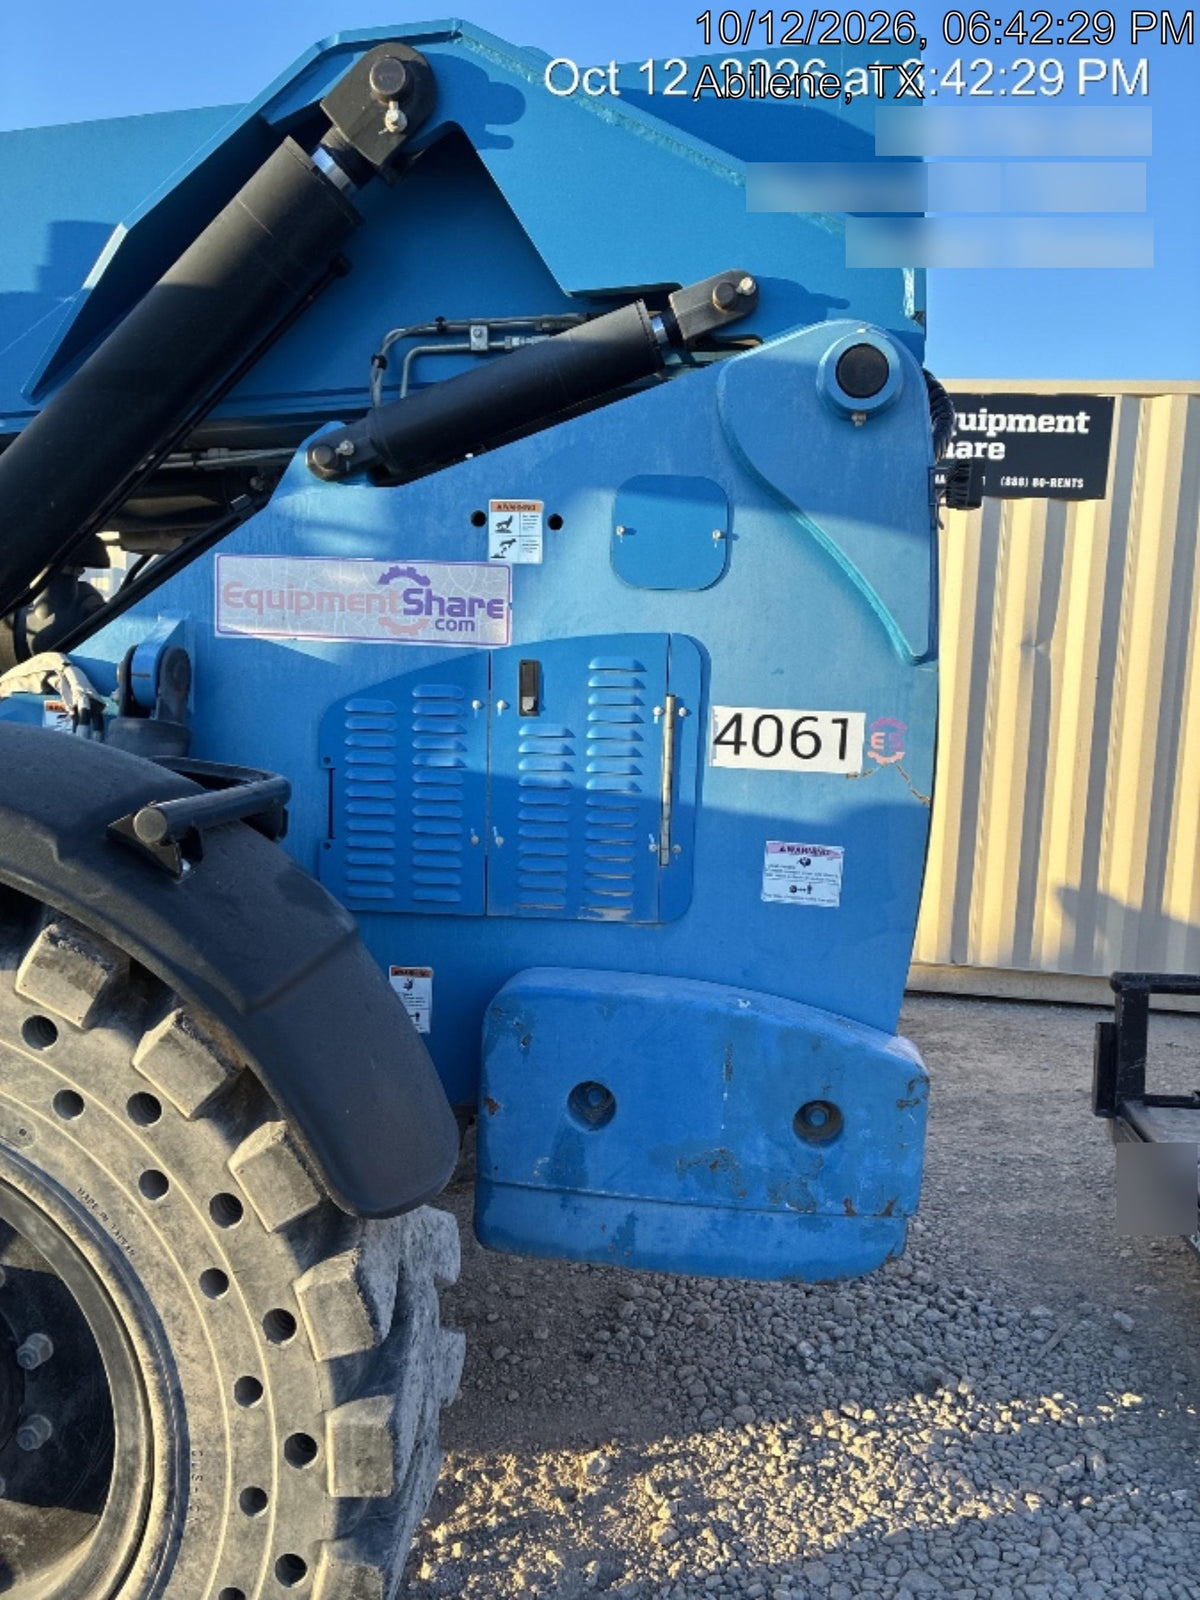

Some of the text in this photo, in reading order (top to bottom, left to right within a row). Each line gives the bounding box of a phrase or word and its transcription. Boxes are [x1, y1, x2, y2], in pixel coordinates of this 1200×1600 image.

[951, 408, 1091, 437] uipment
[222, 580, 504, 619] EquipmentShare
[713, 712, 849, 761] 4061
